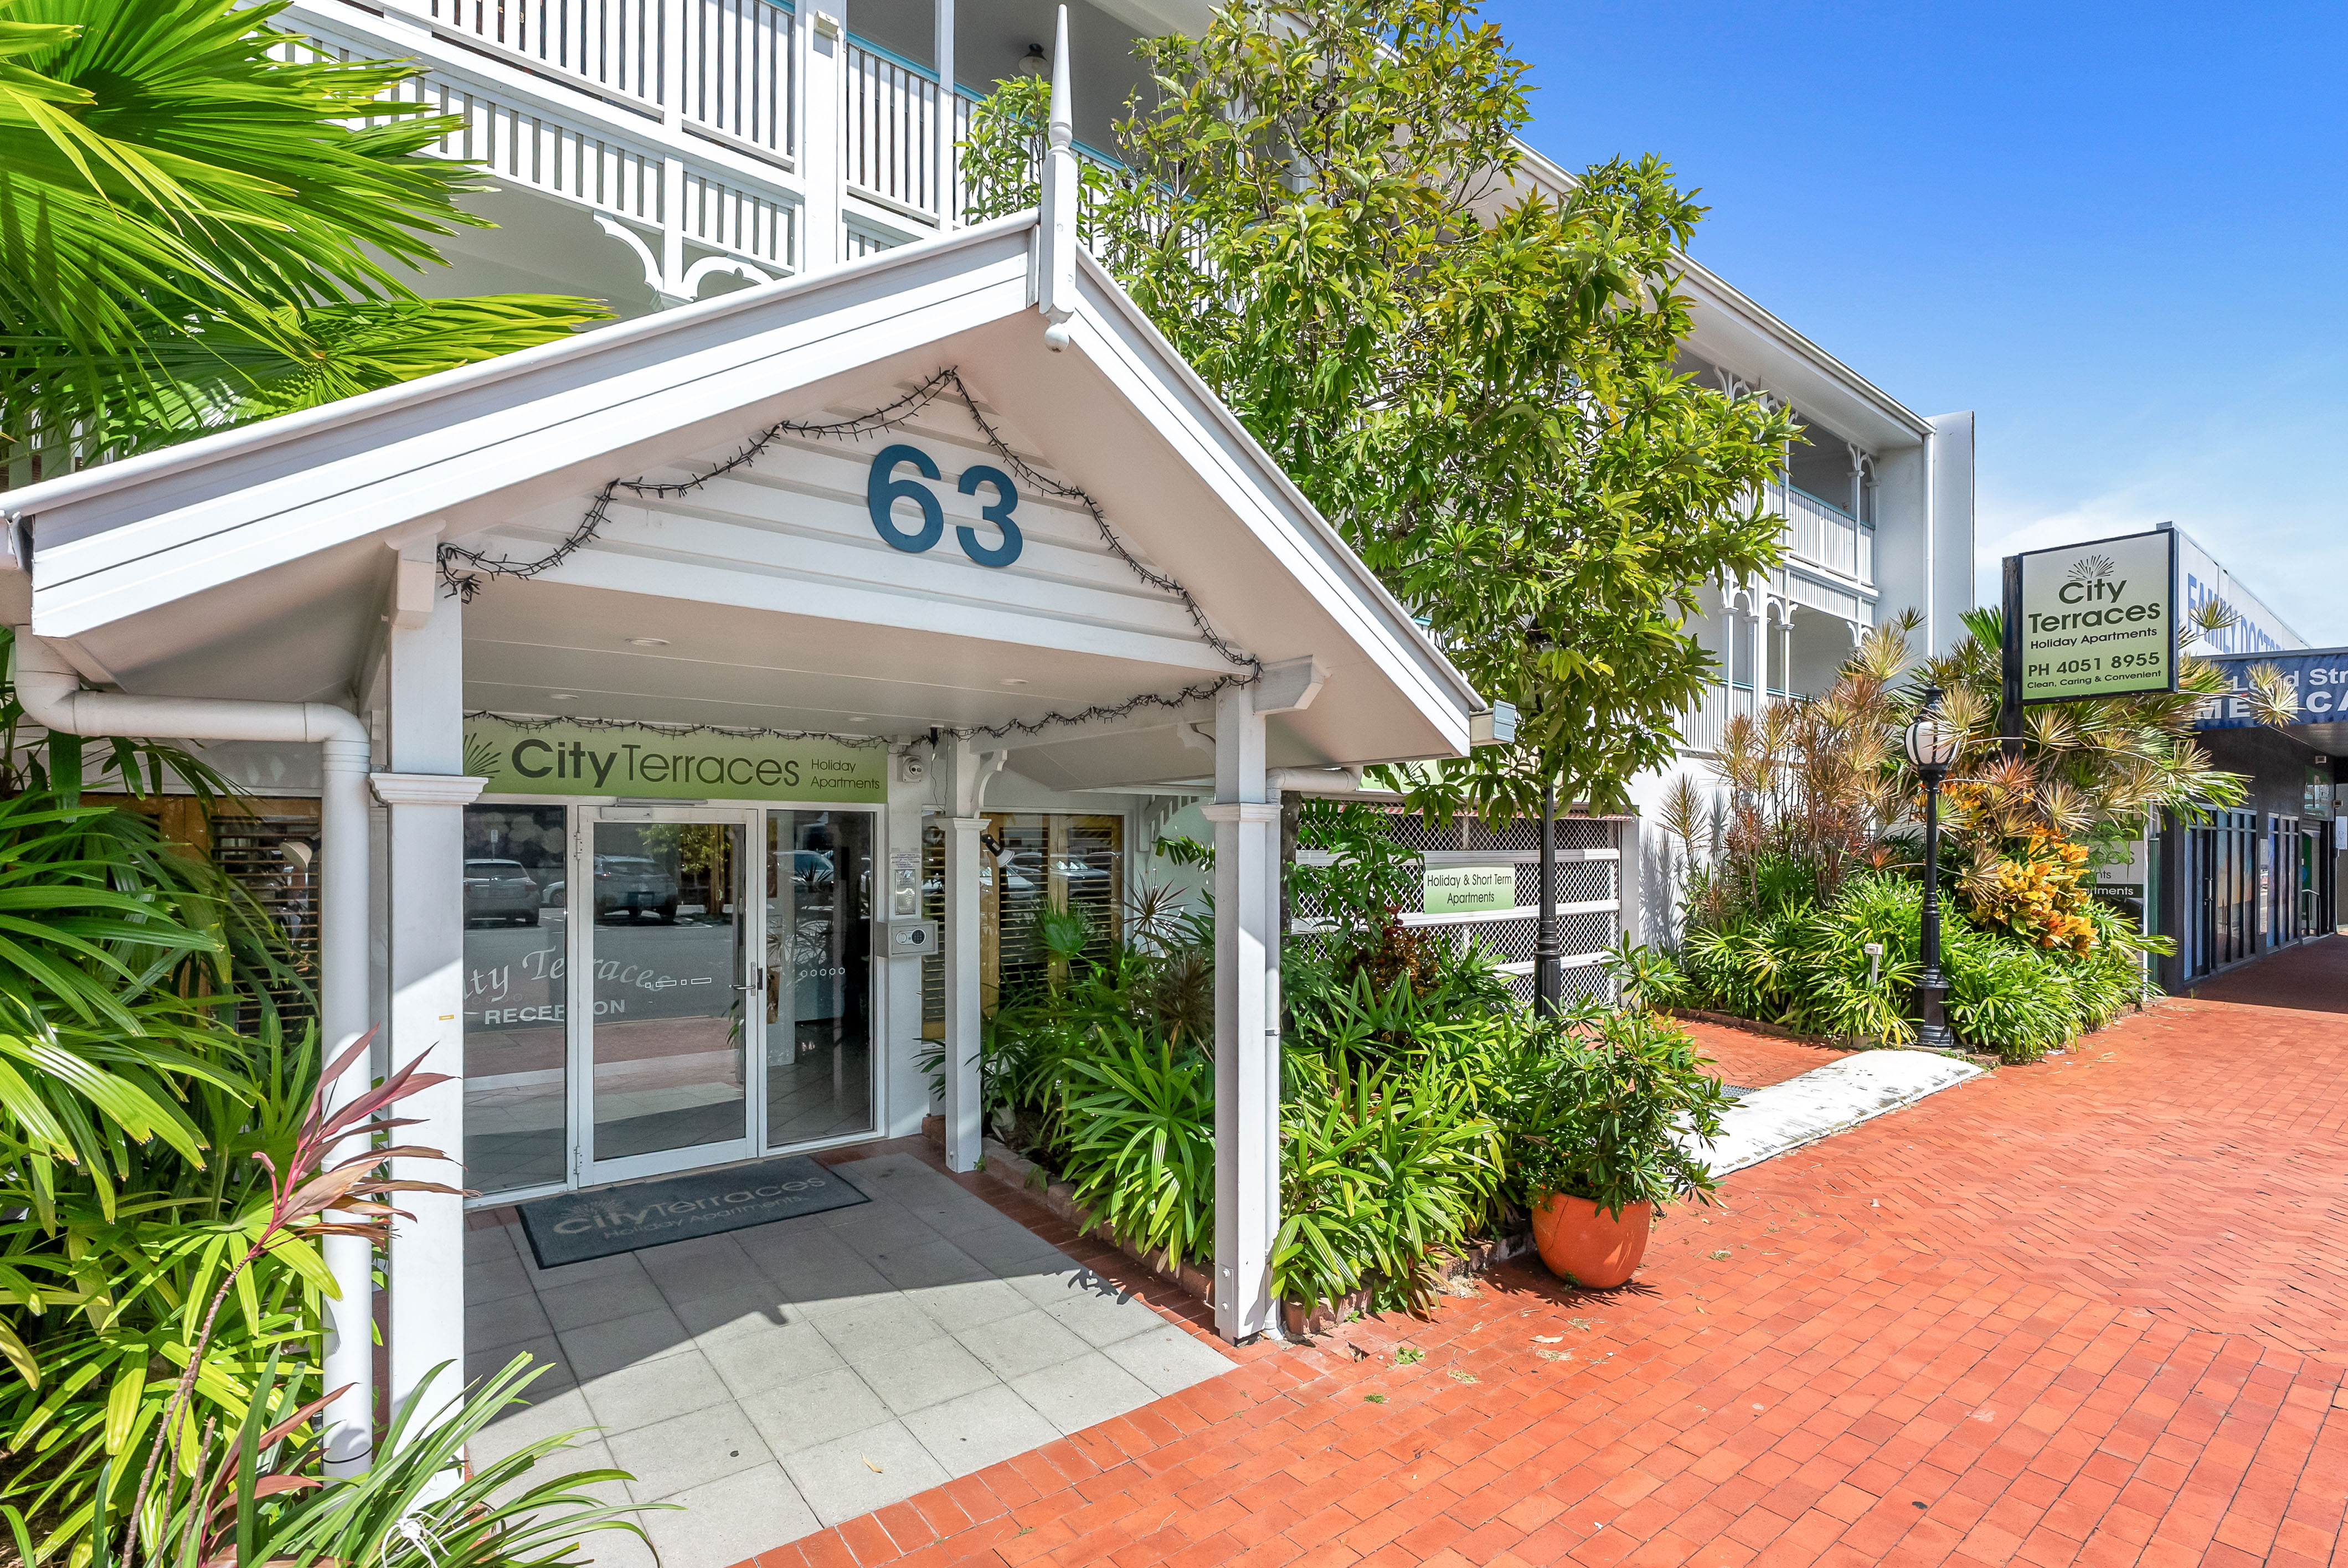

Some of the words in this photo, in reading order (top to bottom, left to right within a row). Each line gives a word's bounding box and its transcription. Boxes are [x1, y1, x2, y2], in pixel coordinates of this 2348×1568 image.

[868, 444, 1023, 568] 63
[2058, 578, 2128, 604] City
[2028, 602, 2161, 633] Terraces
[2030, 637, 2078, 649] Holiday
[2081, 627, 2158, 644] Apartments
[2028, 663, 2050, 677] PH
[2056, 657, 2100, 674] 4051
[2110, 652, 2160, 668] 8955
[2060, 675, 2092, 685] Caring
[2104, 670, 2161, 682] Convenient
[811, 759, 856, 773] Holiday
[811, 776, 880, 789] Apartments
[1427, 875, 1461, 888] Holiday
[1464, 874, 1470, 885] &
[1472, 874, 1492, 885] Short
[1494, 874, 1512, 884] Term
[1447, 891, 1495, 906] Apartments
[464, 965, 509, 1002] ty
[522, 946, 671, 992] Teaces
[485, 999, 626, 1025] RECEPON
